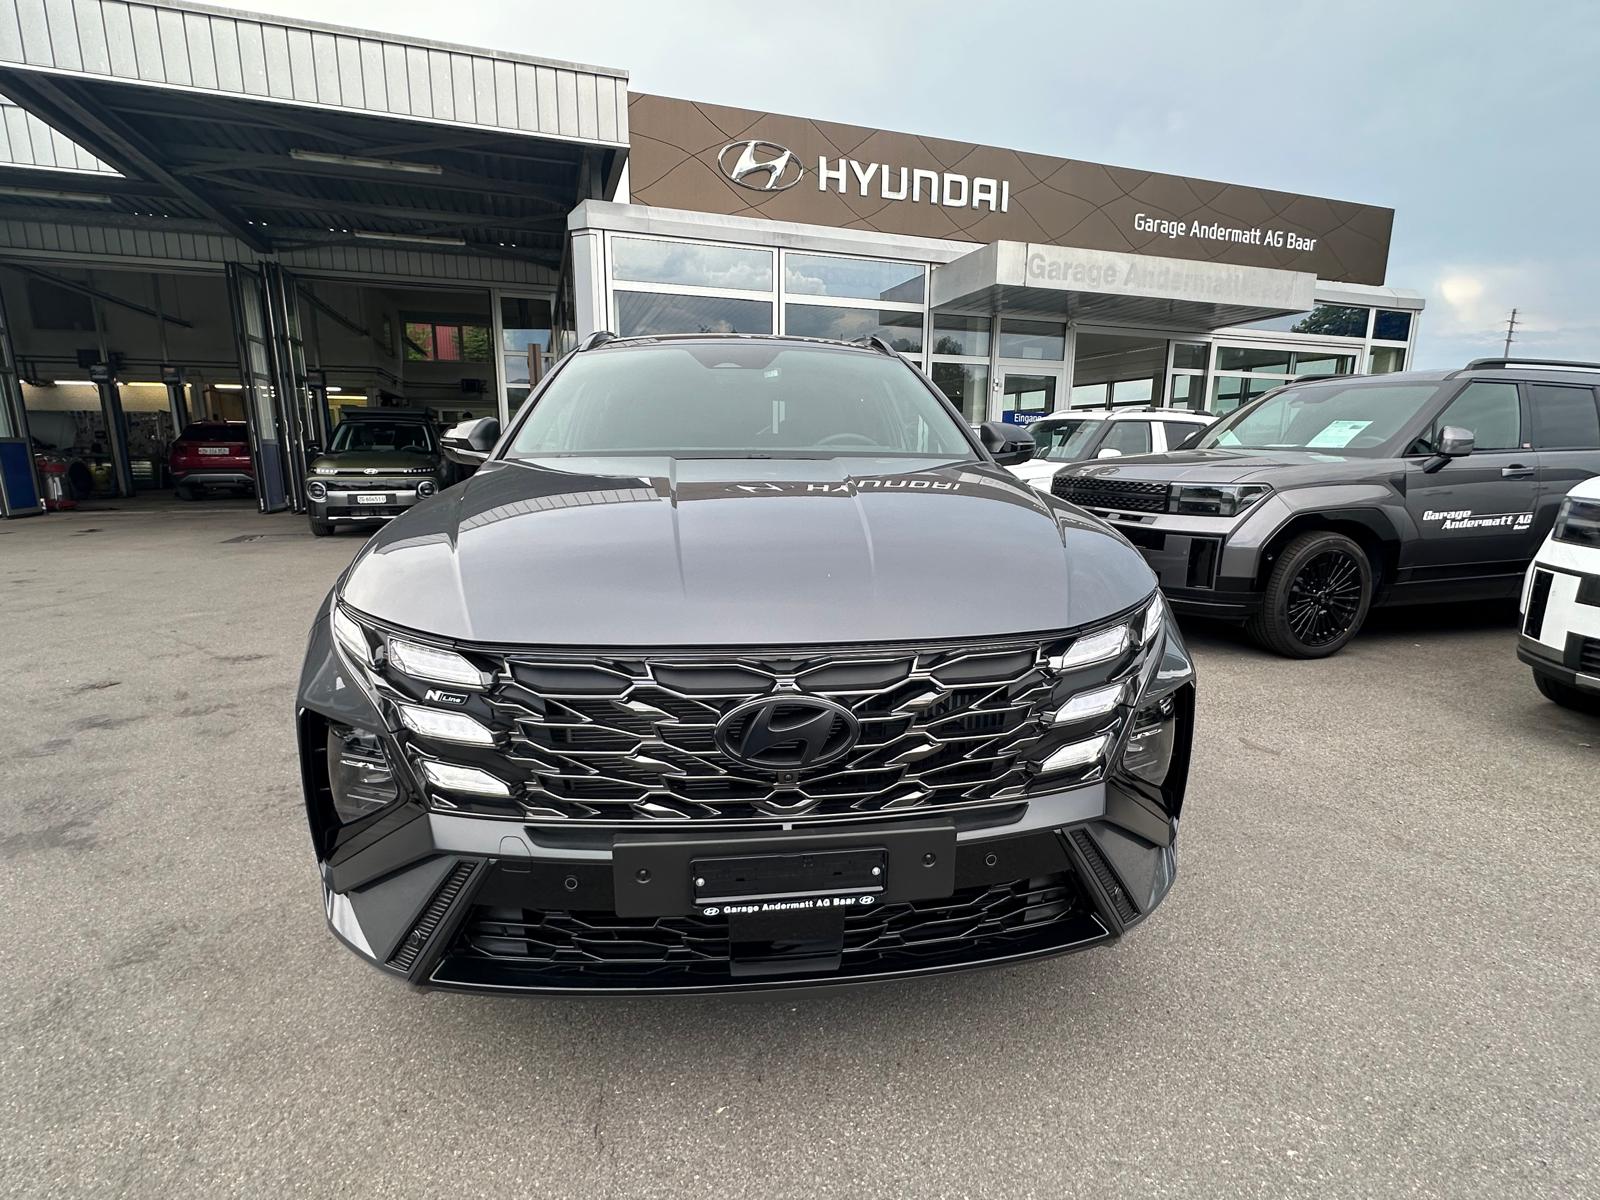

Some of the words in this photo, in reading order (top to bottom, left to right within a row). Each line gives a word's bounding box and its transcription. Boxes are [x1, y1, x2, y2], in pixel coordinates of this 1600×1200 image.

[818, 155, 1009, 213] HYUNDAI
[1134, 213, 1186, 239] Garage
[1190, 220, 1261, 245] Andermatt
[1263, 230, 1284, 248] AG
[1286, 232, 1317, 251] Baar
[1028, 253, 1117, 288] Garage
[1422, 510, 1471, 520] Garage
[1441, 515, 1514, 530] Andermatt
[1515, 514, 1533, 524] AG
[425, 689, 442, 701] N
[724, 906, 759, 914] Garage
[762, 901, 814, 911] Andermatt
[816, 899, 830, 907] AG
